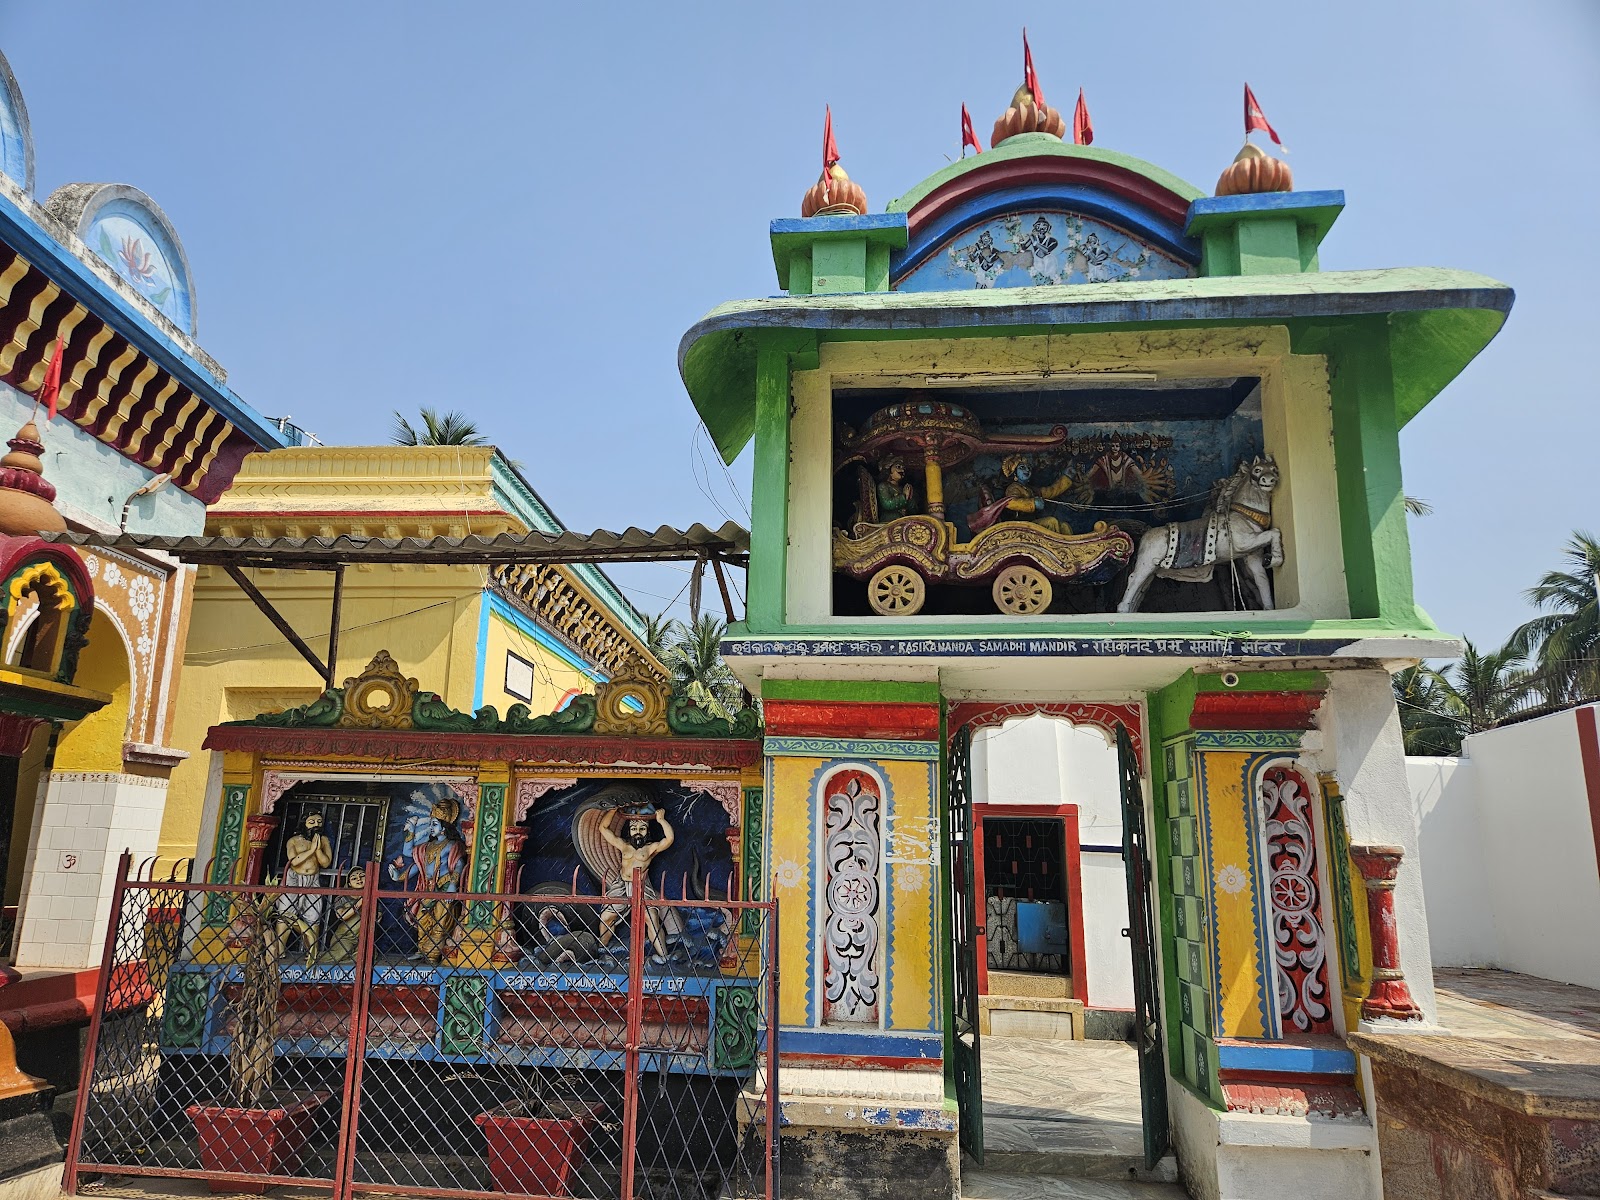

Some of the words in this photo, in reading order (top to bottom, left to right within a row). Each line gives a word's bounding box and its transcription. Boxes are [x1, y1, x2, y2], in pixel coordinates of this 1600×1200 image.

[898, 641, 975, 654] RASIKANANDA
[979, 641, 1026, 652] SAMADHI
[1029, 641, 1078, 653] MANDIR
